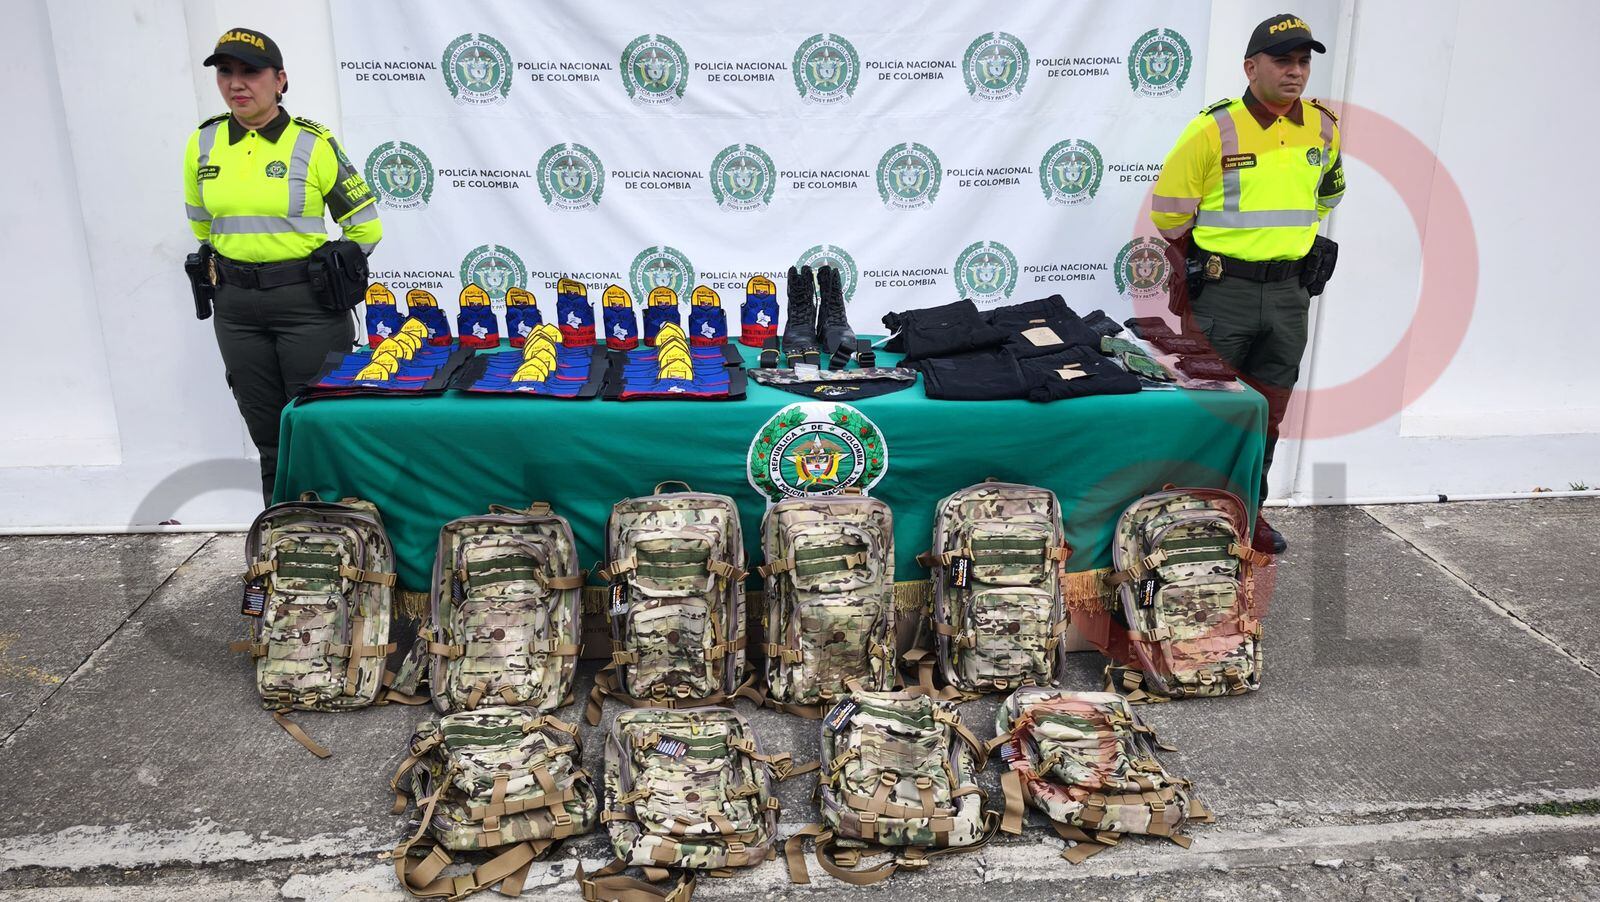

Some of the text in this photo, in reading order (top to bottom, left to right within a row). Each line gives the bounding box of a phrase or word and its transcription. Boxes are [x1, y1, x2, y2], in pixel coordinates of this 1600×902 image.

[341, 60, 437, 71] POLICÍA NACIONAL
[695, 61, 787, 71] POLICÍA NACIONAL
[866, 59, 956, 70] POLICÍA NACIONAL
[1036, 57, 1122, 67] POLICÍA NACIONAL
[518, 61, 612, 73] POLICÍA NACIONAL
[356, 73, 425, 81] DE COLOMBIA
[892, 72, 944, 80] COLOMBIA
[1048, 68, 1109, 77] DE COLOMBIA
[708, 74, 720, 82] DE
[1109, 163, 1146, 172] POLICÍA
[439, 168, 532, 180] POLICÍA NACIONAL
[612, 170, 703, 179] POLICÍA NACIONAL
[781, 169, 870, 180] POLICÍA NACIONAL
[947, 167, 1033, 178] POLICÍA NACIONAL
[467, 180, 519, 188] COLOMBIA
[638, 182, 691, 190] COLOMBIA
[793, 181, 857, 189] DE COLOMBIA
[974, 177, 1020, 186] COLOMBIA
[902, 268, 949, 276] NACIONAL
[1024, 263, 1108, 272] POLICÍA NACIONAL
[369, 270, 455, 279] OLICÍA NACIONAL
[532, 270, 622, 280] POLICÍA NACIONAL
[1048, 273, 1095, 281] COLOMBIA
[545, 282, 563, 290] DE
[713, 282, 725, 290] DE
[889, 279, 936, 287] COLOMBIA
[772, 432, 798, 472] REPUBLICA
[840, 432, 864, 466] COLOMBIA
[778, 483, 805, 497] POLICIA
